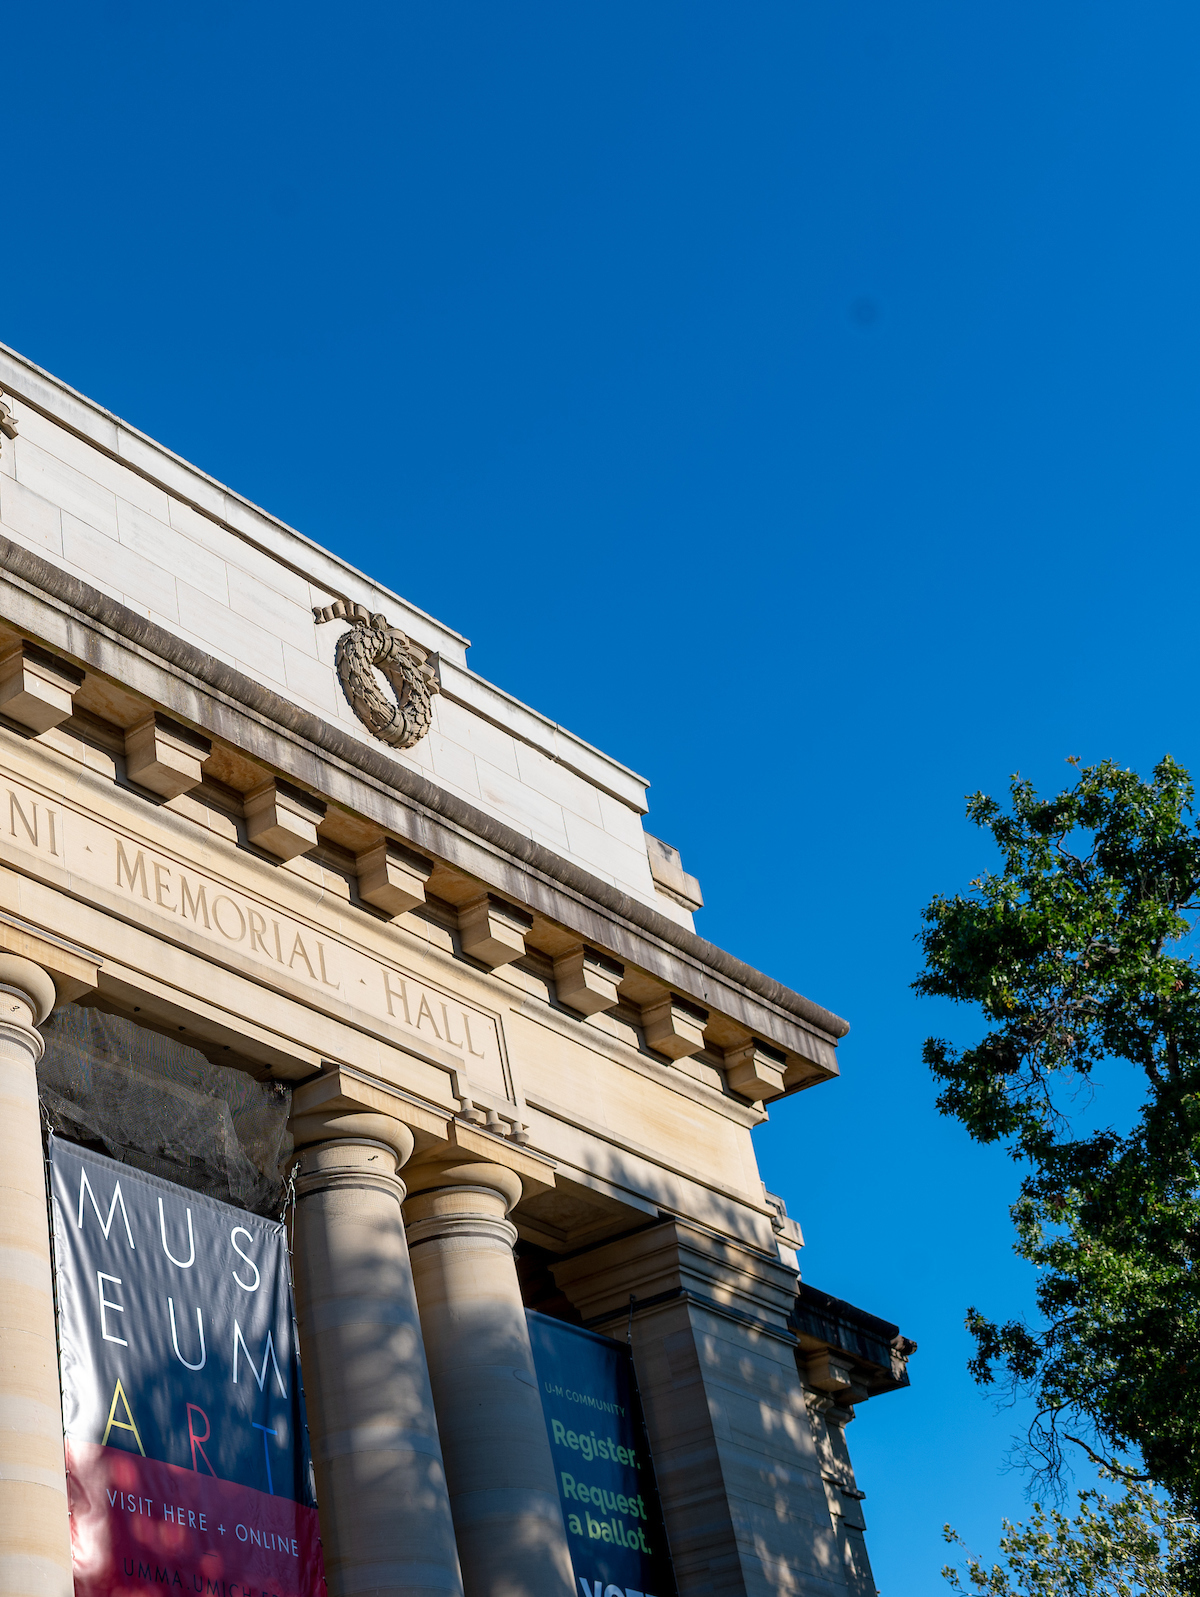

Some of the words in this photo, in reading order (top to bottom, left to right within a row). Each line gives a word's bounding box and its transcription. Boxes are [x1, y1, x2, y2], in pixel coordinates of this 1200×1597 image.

[115, 837, 341, 990] MEMORIAL
[380, 967, 485, 1058] HALL
[545, 1381, 564, 1397] U-M
[566, 1389, 626, 1418] COMMUNITY
[551, 1418, 641, 1470] Register.
[560, 1471, 647, 1521] Request
[106, 1488, 153, 1517] VISIT
[163, 1503, 207, 1532] HERE
[235, 1523, 299, 1557] ONLINE
[568, 1513, 583, 1536] a
[586, 1510, 652, 1555] ballot.
